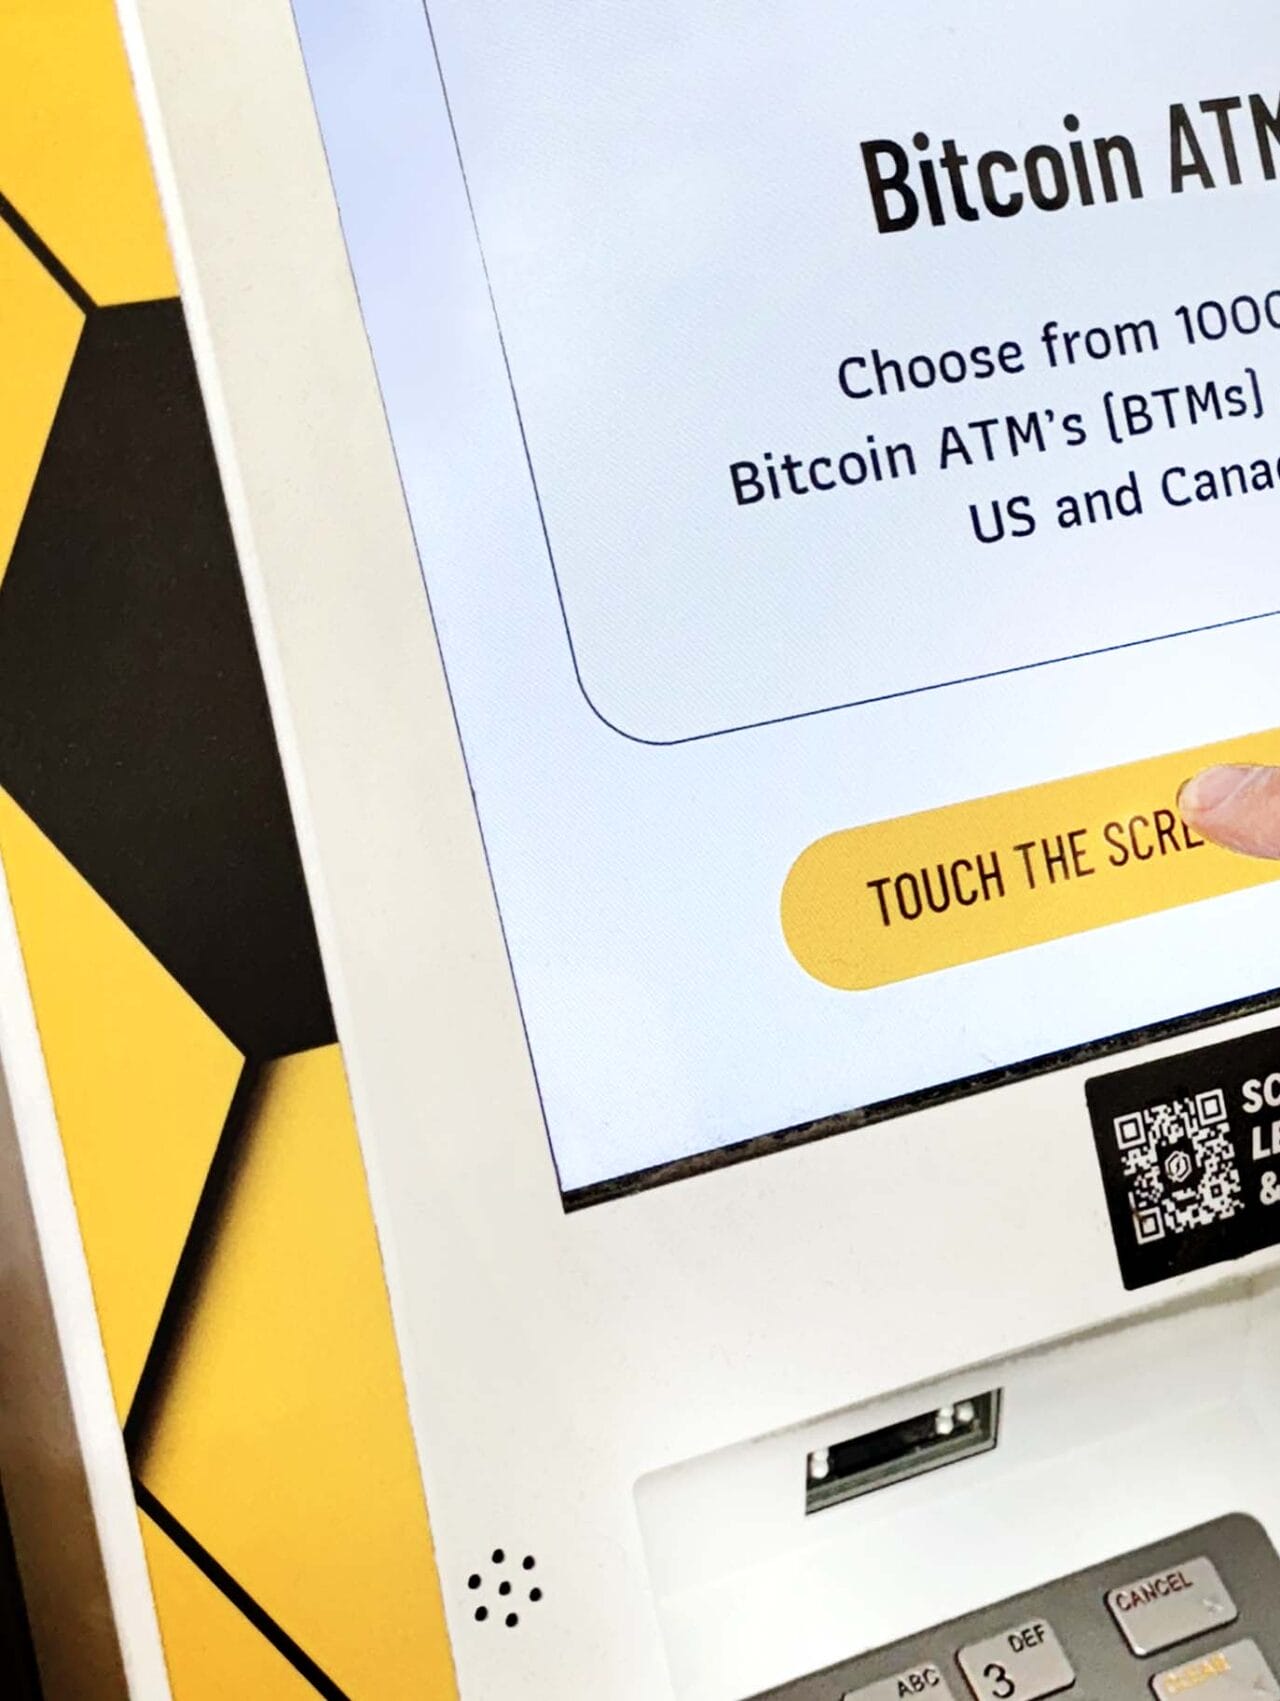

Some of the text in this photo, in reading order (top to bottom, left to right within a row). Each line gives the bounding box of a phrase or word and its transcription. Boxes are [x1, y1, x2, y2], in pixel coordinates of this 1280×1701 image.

[859, 113, 1144, 234] Bitcoin
[838, 341, 1025, 399] Choose
[1041, 320, 1159, 368] from
[729, 434, 917, 506] Bitcoin
[940, 409, 1087, 470] ATM's
[969, 495, 1036, 544] US
[1056, 470, 1143, 529] and
[866, 850, 1006, 927] TOUCH
[1012, 828, 1095, 890] THE
[1103, 809, 1205, 867] SCR
[1115, 1571, 1193, 1612] CANCEL
[1007, 1624, 1046, 1654] DEF
[897, 1668, 940, 1698] ABC
[983, 1663, 1016, 1699] 3
